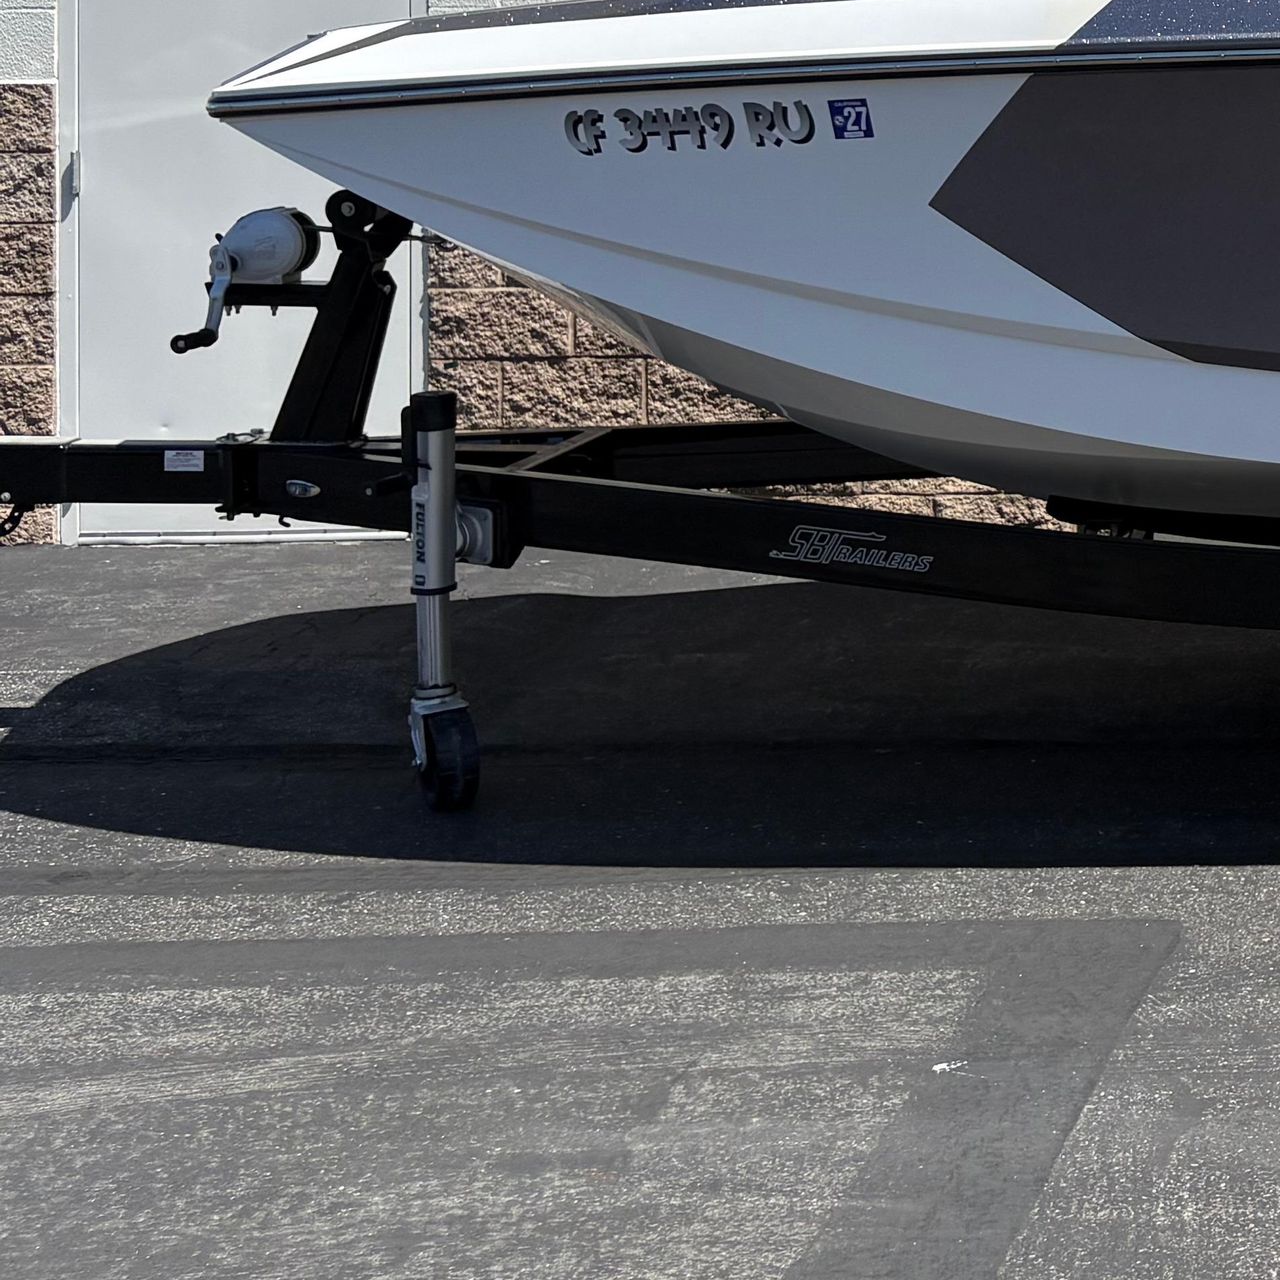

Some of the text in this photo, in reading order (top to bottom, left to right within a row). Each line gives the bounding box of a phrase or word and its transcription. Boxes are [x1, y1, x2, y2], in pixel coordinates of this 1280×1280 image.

[563, 99, 816, 156] CF 3449 RU
[843, 106, 867, 131] 27
[415, 502, 425, 564] FULTON
